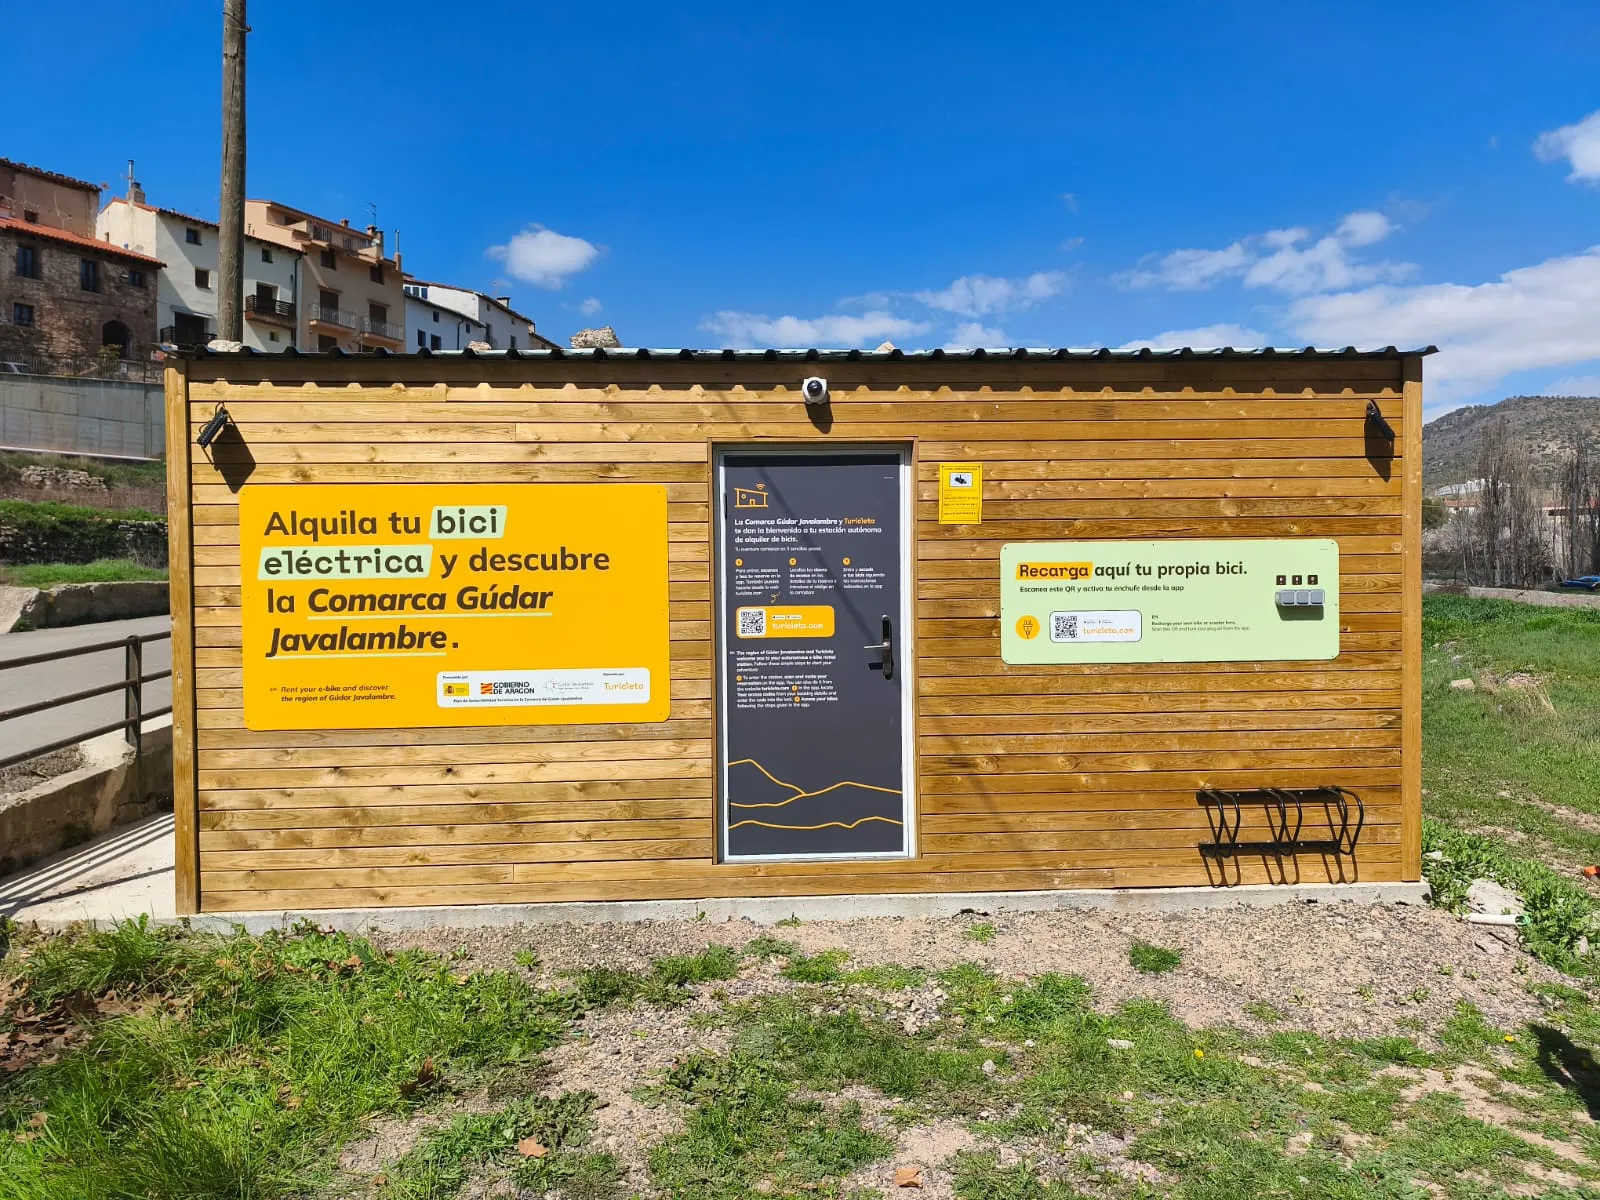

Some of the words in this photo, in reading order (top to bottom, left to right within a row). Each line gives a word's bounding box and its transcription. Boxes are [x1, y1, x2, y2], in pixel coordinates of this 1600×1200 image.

[264, 511, 377, 542] Alquila
[388, 512, 421, 535] tu
[437, 508, 497, 534] bici
[734, 518, 744, 526] La
[776, 517, 799, 525] Gúdar
[798, 517, 838, 526] Javalambre
[844, 517, 876, 525] Turicleta
[818, 526, 846, 534] estación
[847, 526, 882, 534] autónoma
[744, 535, 770, 545] alquiler
[770, 535, 780, 543] de
[264, 547, 424, 576] eléctrica
[440, 553, 468, 579] y
[469, 546, 610, 572] descubre
[1018, 563, 1090, 580] Recarga
[1094, 562, 1131, 579] aquí
[1135, 562, 1152, 576] tu
[1157, 561, 1211, 579] propia
[1215, 561, 1248, 576] bici.
[1064, 585, 1076, 593] QR
[1141, 583, 1162, 591] desde
[1162, 583, 1170, 591] la
[1170, 584, 1185, 592] app
[267, 588, 295, 614] la
[308, 588, 447, 613] Comarca
[456, 584, 554, 611] Gúdar
[318, 684, 341, 692] e-bike
[493, 681, 531, 690] GOBIERNO
[604, 681, 645, 690] Turicleta
[294, 695, 318, 704] region
[352, 693, 397, 701] Javalambre.
